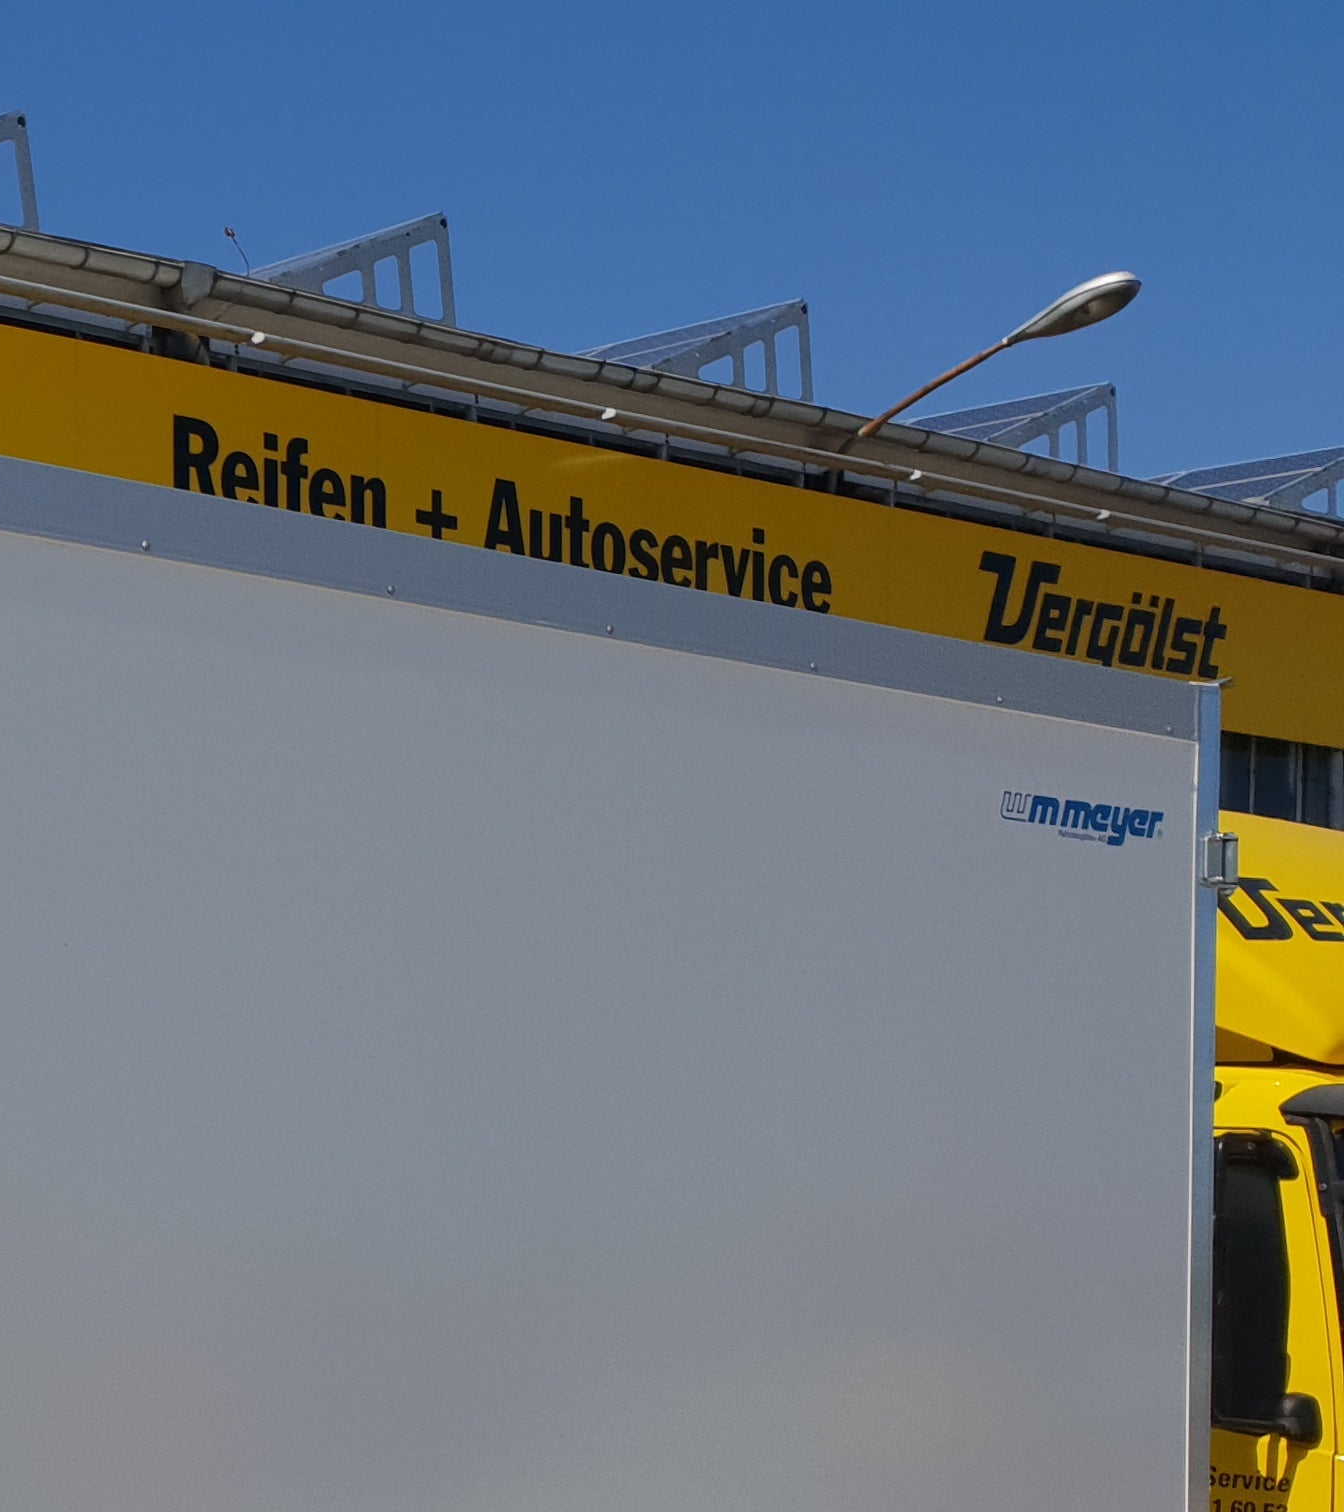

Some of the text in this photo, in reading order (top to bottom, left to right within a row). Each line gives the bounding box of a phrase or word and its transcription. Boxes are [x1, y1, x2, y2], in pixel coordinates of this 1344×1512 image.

[173, 413, 833, 615] Reifen + Autoservice
[978, 550, 1228, 680] Vergölst
[1209, 1465, 1291, 1493] Service
